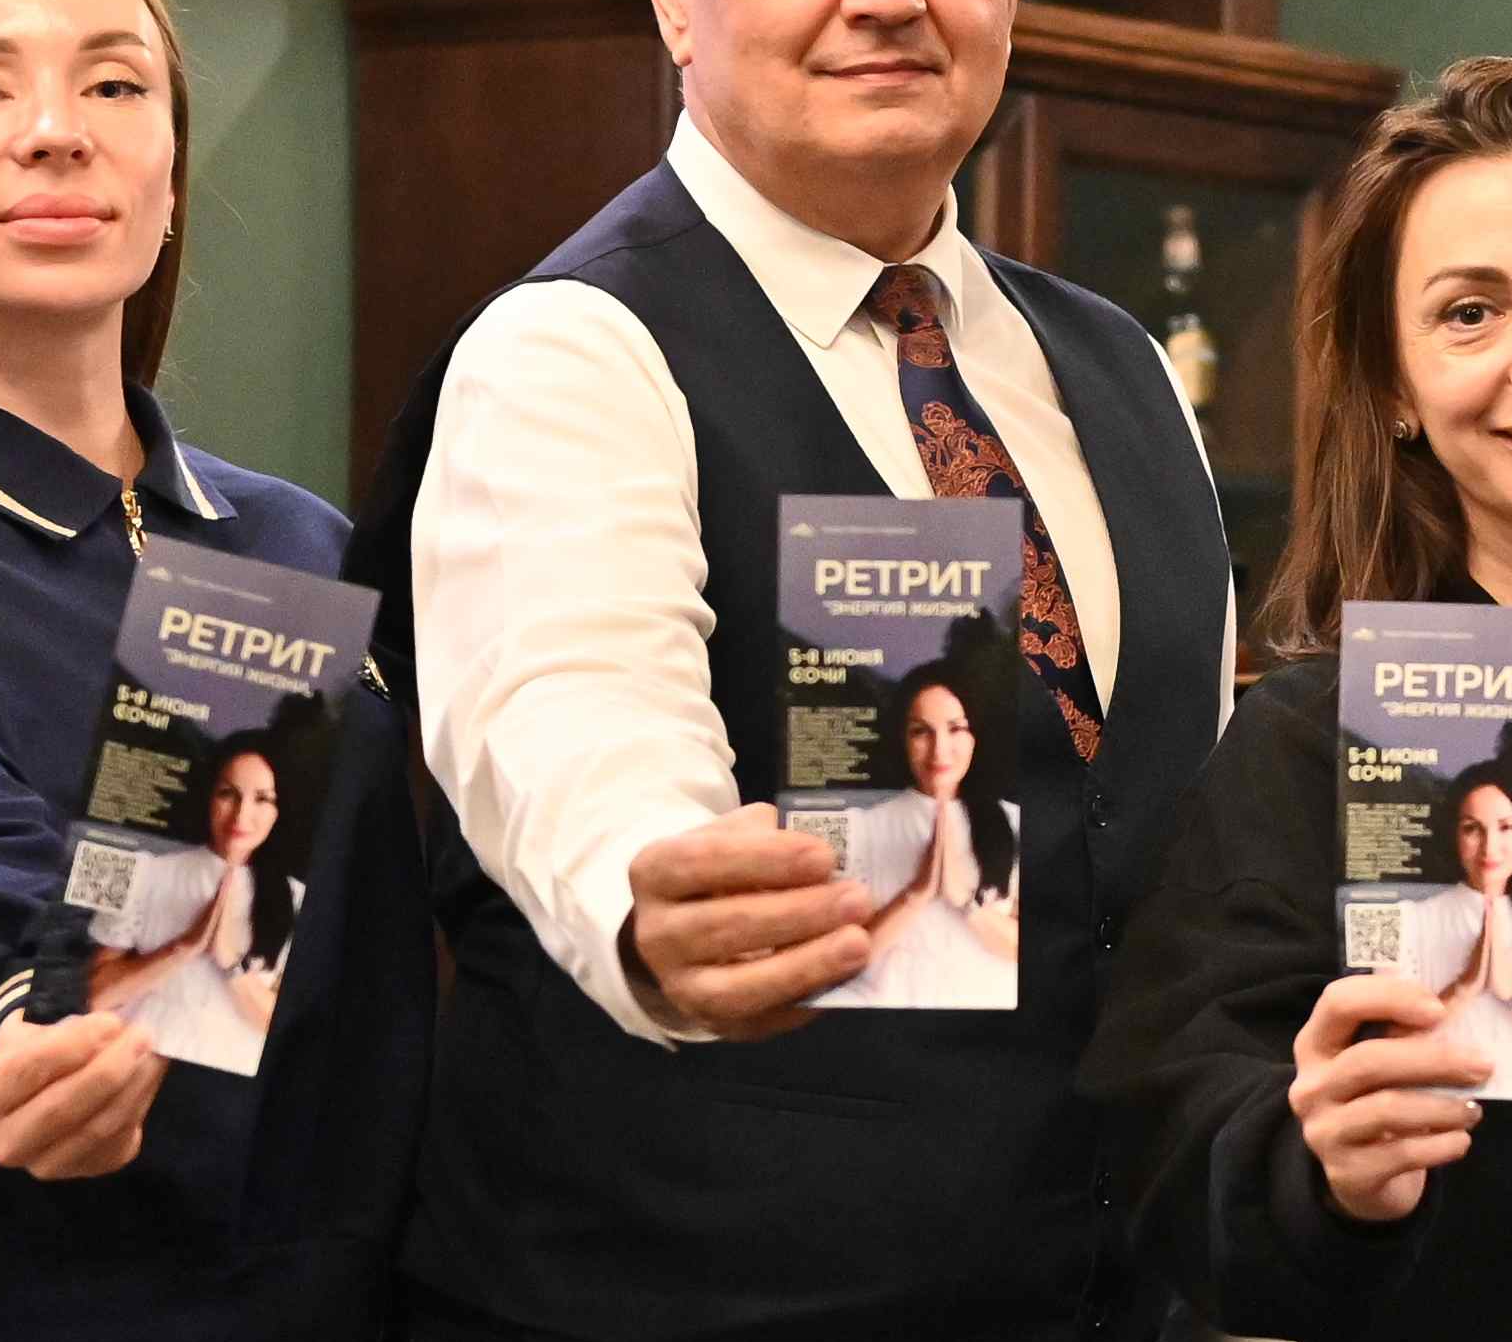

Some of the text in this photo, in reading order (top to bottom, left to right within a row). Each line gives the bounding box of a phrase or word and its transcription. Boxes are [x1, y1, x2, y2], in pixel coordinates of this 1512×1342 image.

[814, 559, 991, 596] РЕТРИТ
[158, 606, 336, 678] РЕТРИТ
[823, 648, 884, 666] ИЮНЯ
[788, 666, 847, 684] СОЧИ
[112, 703, 170, 731] СОЧИ
[1348, 765, 1402, 782] СОЧИ
